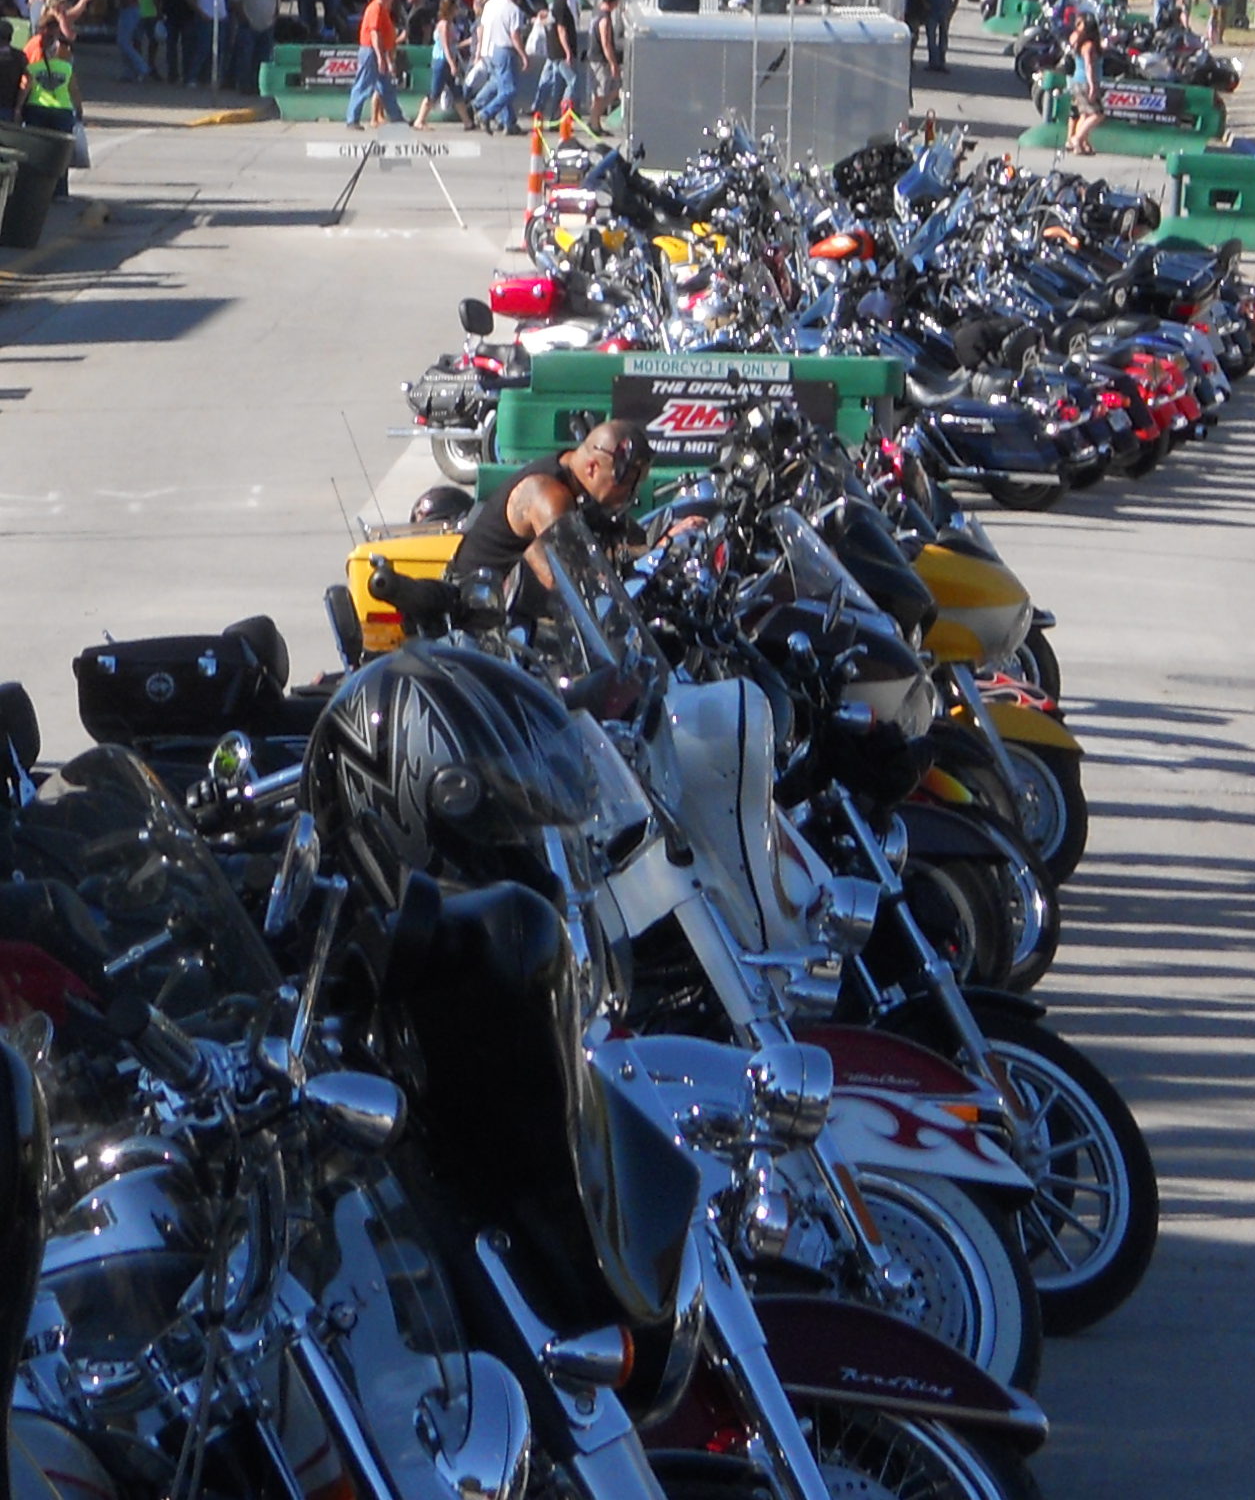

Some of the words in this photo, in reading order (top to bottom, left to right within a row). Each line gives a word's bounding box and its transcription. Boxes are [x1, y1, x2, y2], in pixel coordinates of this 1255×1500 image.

[1102, 90, 1166, 111] AMSOIL
[742, 362, 779, 376] ONLY
[652, 380, 686, 395] THE
[768, 384, 794, 397] OIL
